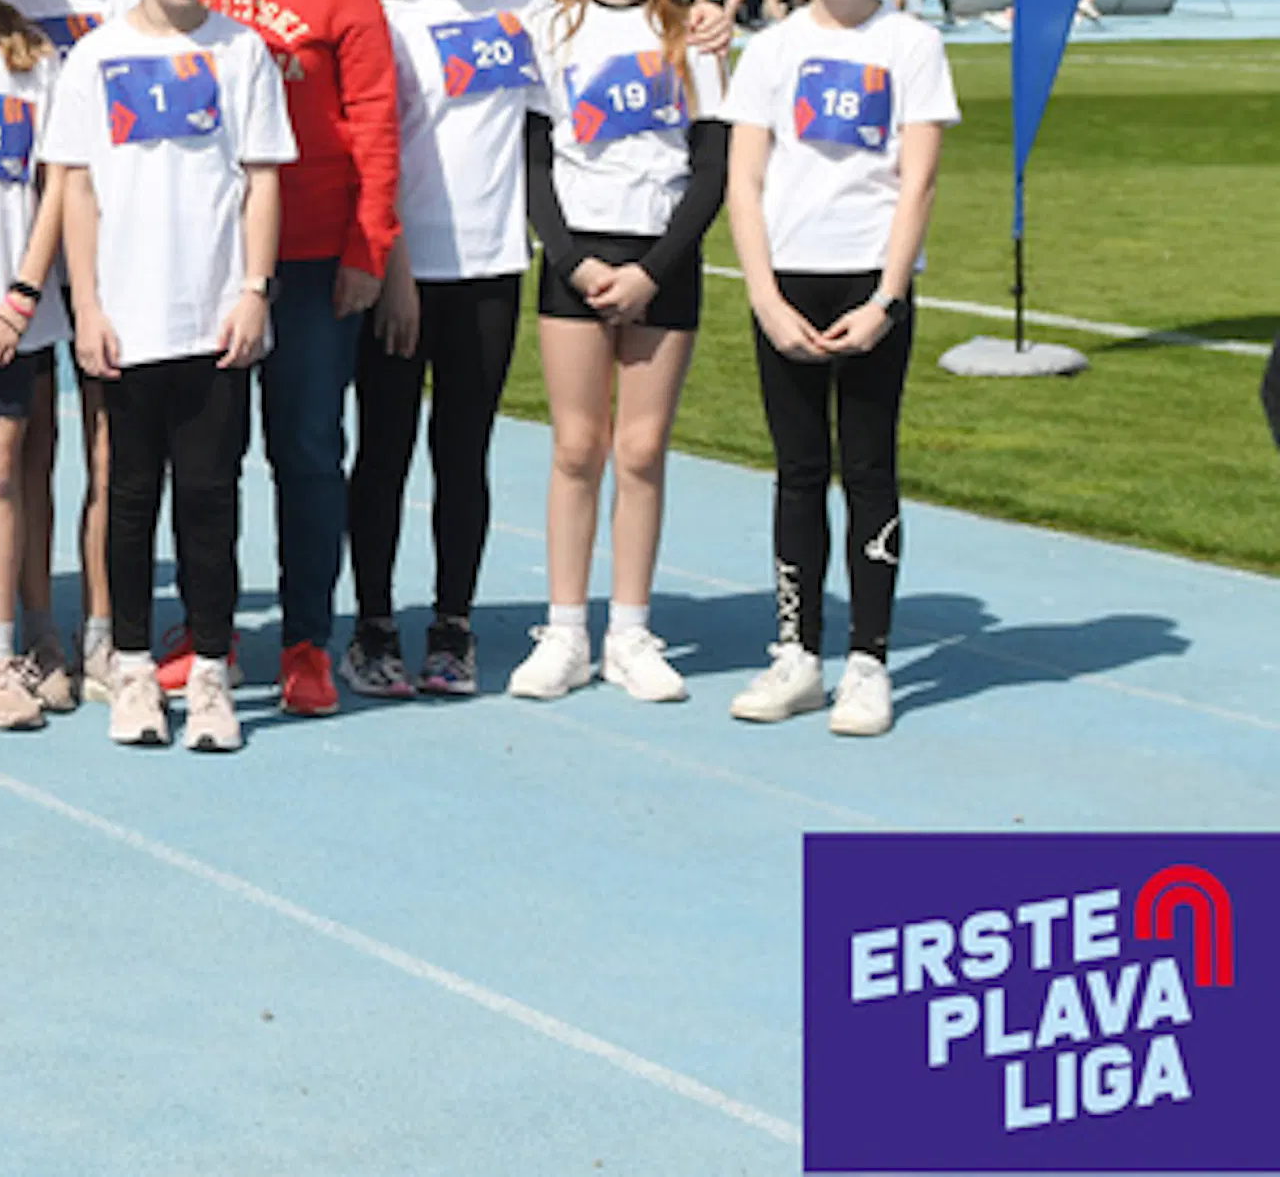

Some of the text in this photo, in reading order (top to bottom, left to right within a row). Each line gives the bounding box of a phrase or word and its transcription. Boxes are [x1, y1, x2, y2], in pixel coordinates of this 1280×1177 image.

[471, 38, 514, 68] 20
[148, 83, 167, 113] 1
[606, 80, 647, 112] 19
[821, 88, 860, 120] 18
